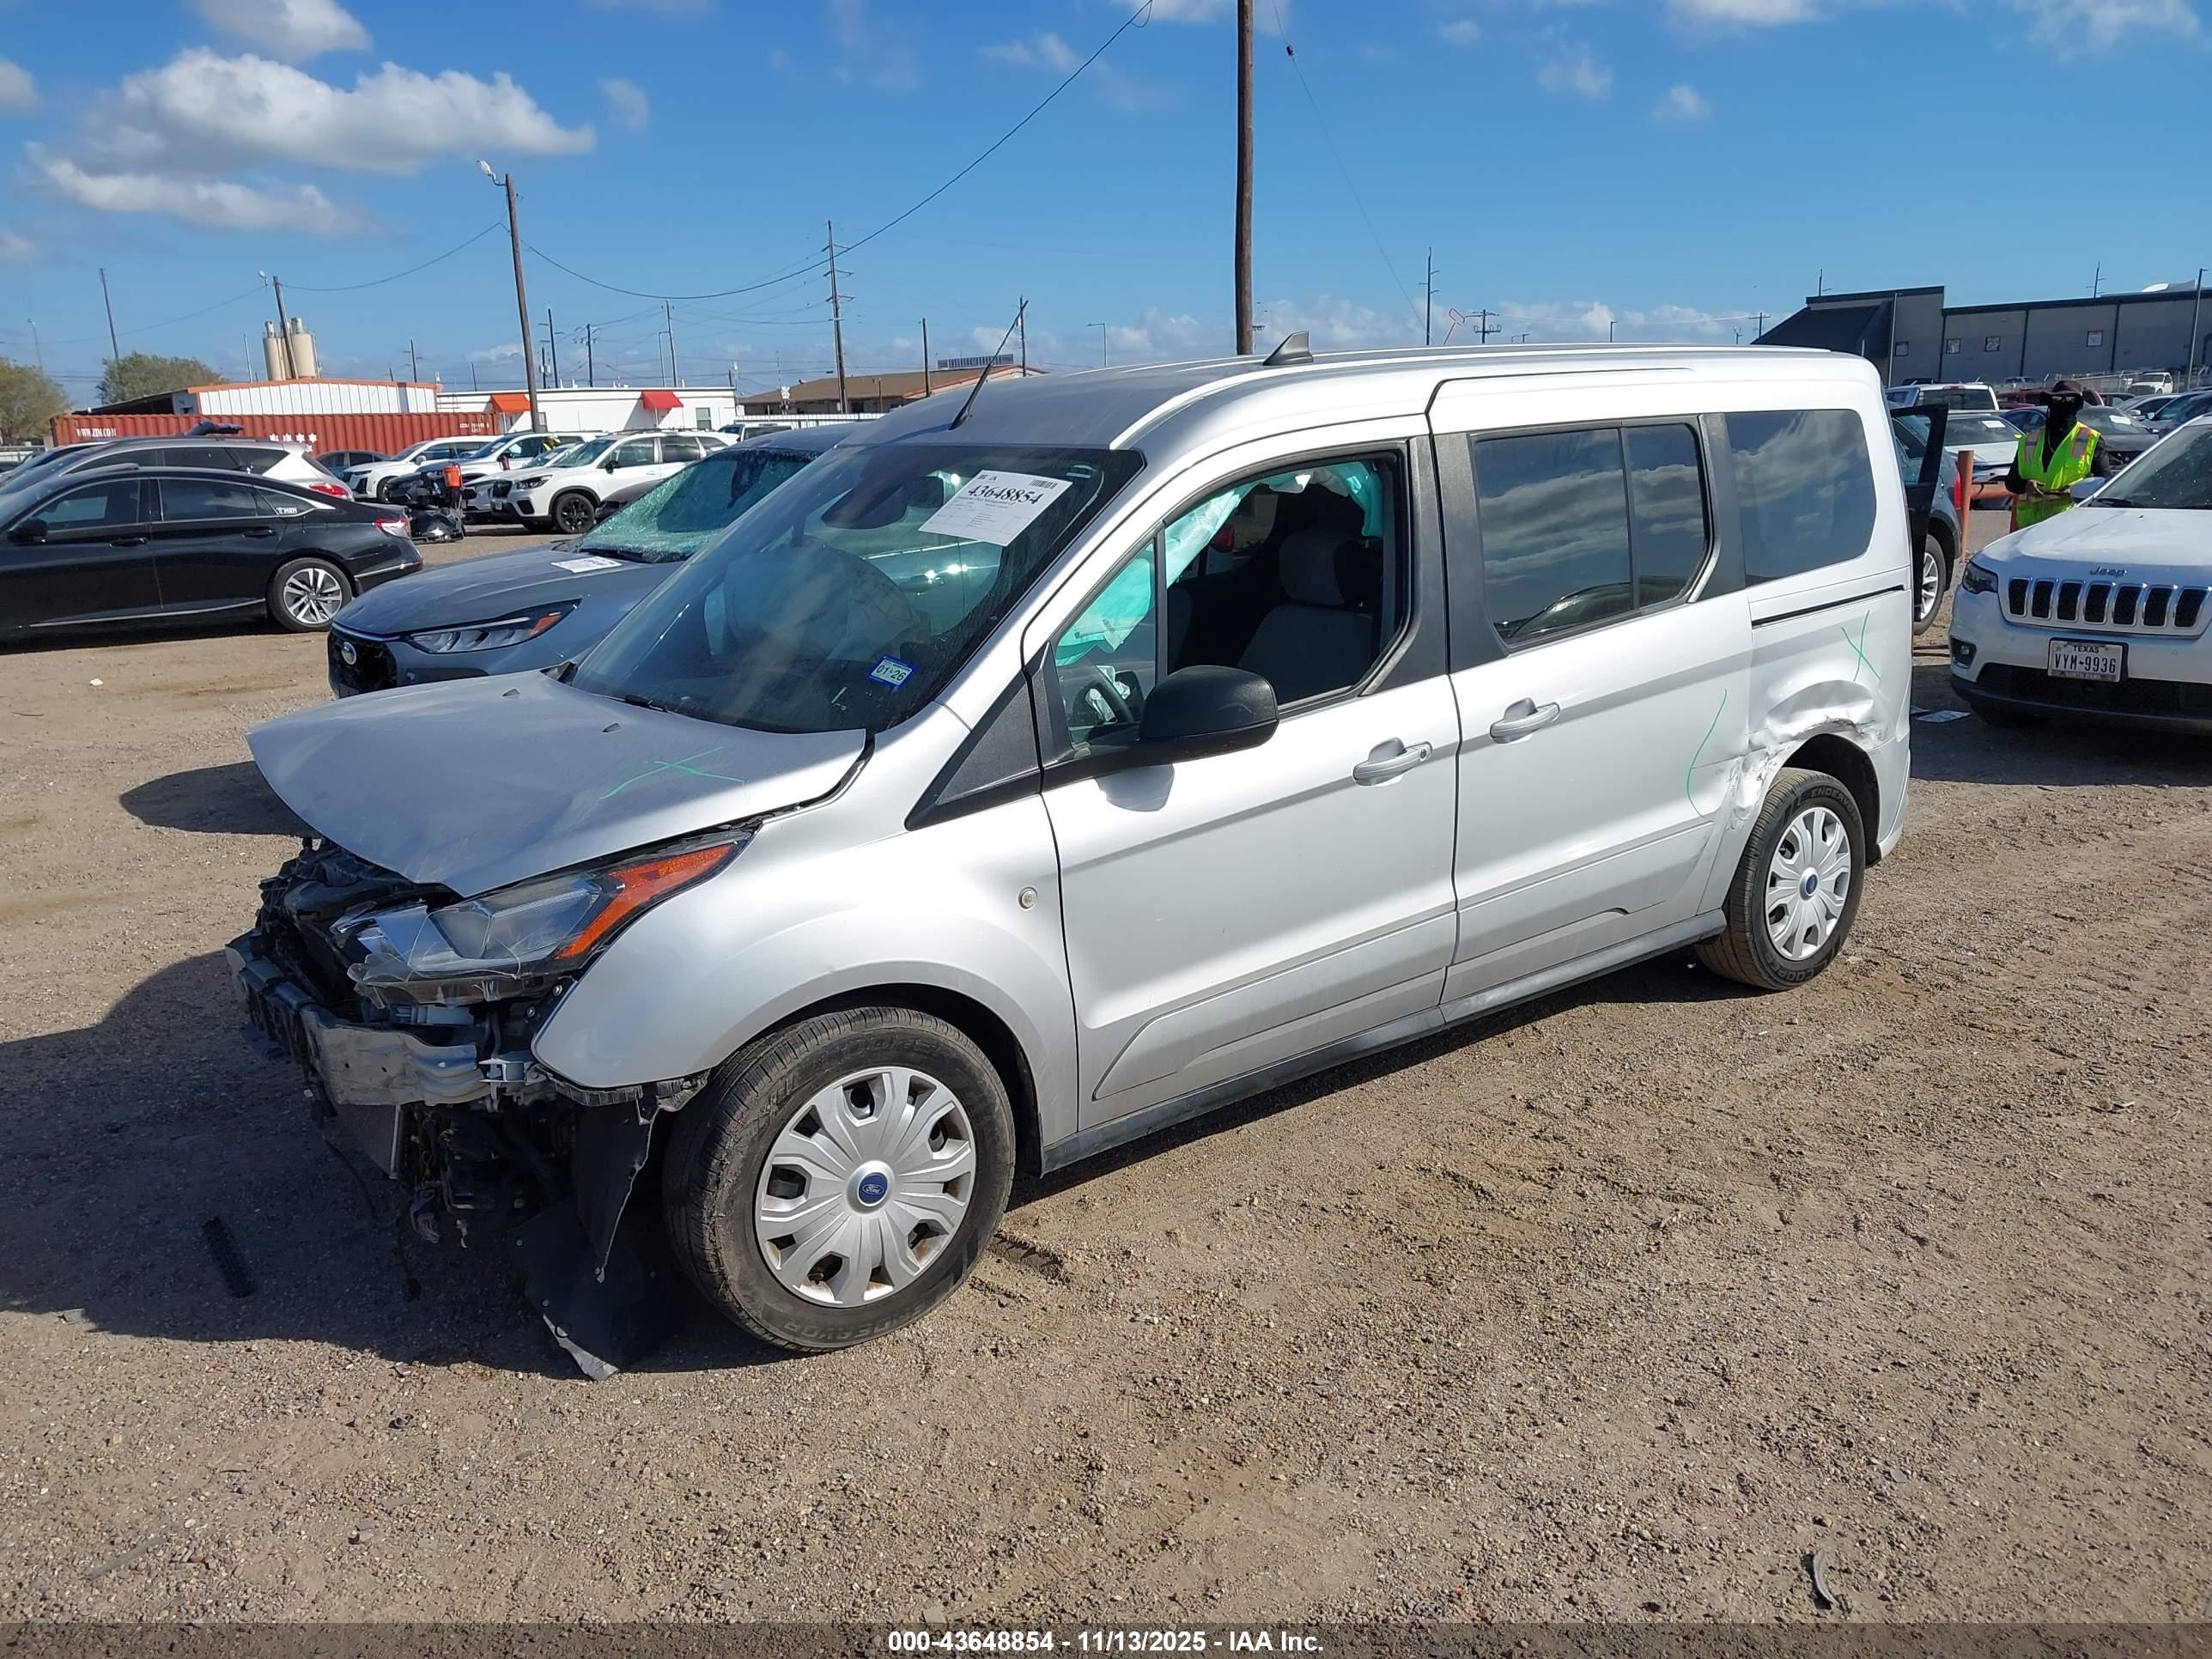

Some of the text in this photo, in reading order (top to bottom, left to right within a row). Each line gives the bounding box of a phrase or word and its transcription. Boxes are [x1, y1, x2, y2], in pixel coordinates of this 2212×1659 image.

[76, 428, 117, 438] WWW.ZIM.COM
[967, 483, 1045, 506] 43648854
[2090, 566, 2128, 578] Jeep
[2073, 645, 2100, 654] TEXAS
[876, 665, 907, 681] 01 26
[866, 1183, 881, 1194] Ford
